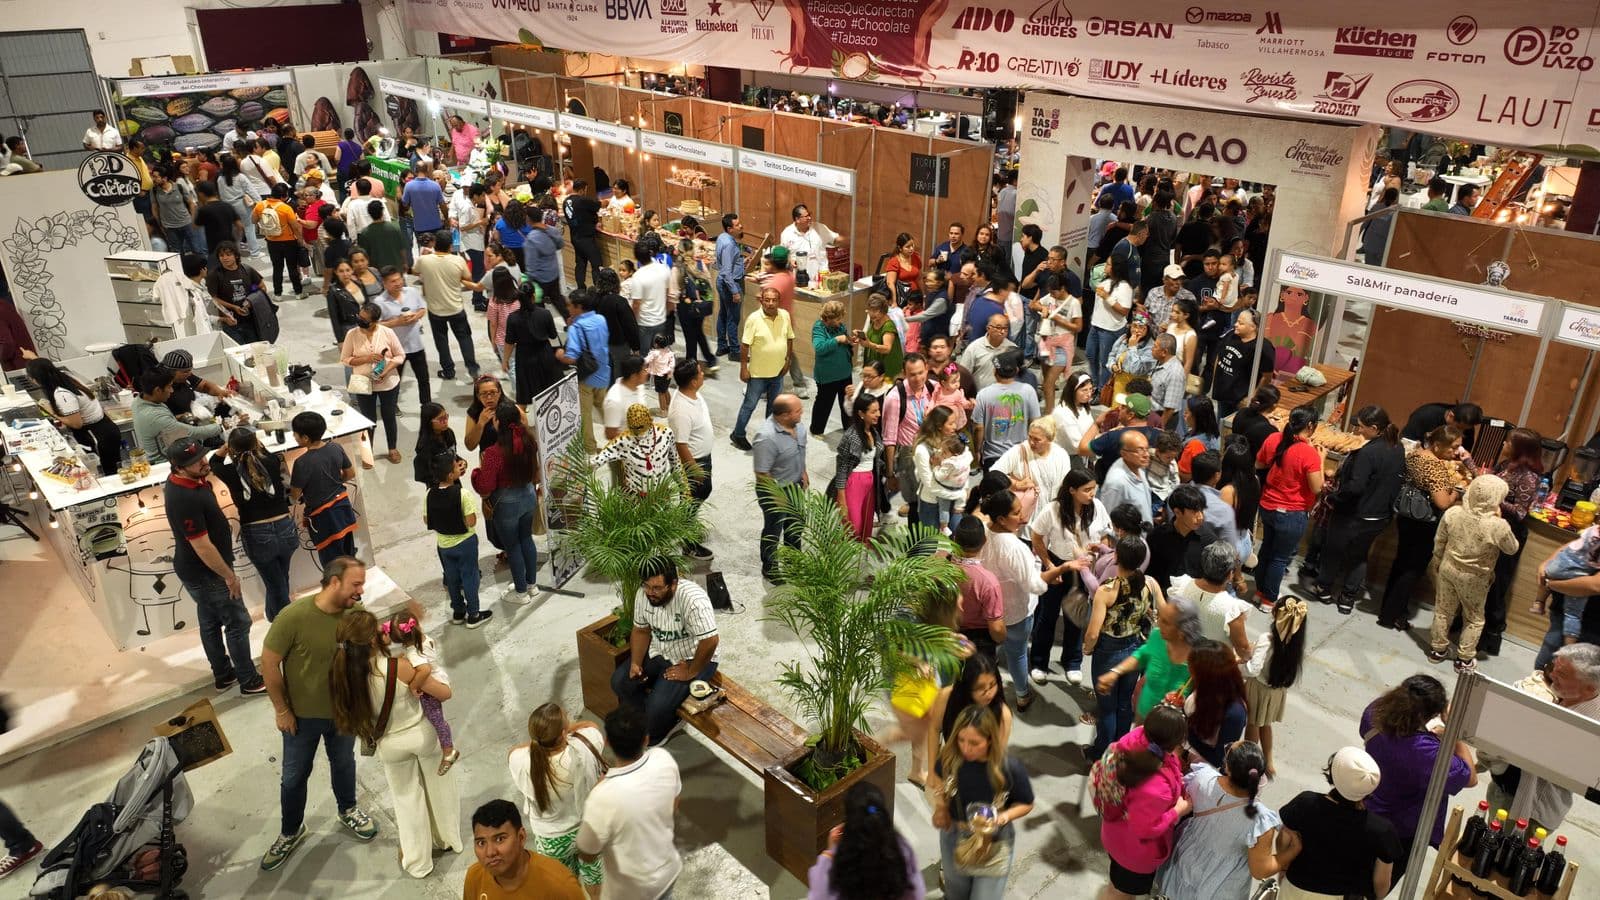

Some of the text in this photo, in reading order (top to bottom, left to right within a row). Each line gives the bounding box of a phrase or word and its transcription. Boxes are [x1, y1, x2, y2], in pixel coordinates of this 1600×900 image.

[606, 0, 652, 20] BBVA
[695, 19, 738, 32] Heineken
[812, 15, 911, 34] #Cacao #Chocolate
[951, 6, 1015, 33] ADO
[1086, 16, 1174, 39] ORSAN
[831, 31, 878, 46] #Tabasco
[1022, 23, 1078, 39] CRUCES
[1335, 26, 1417, 48] Küchen
[1549, 25, 1579, 41] PO
[1197, 38, 1230, 50] Tabasco
[1260, 37, 1305, 46] MARRIOTT
[1546, 42, 1573, 55] ZO
[1258, 47, 1325, 57] VILLAHERMOSA
[1426, 52, 1485, 64] FOTON
[1542, 55, 1594, 72] LAZO
[1150, 68, 1227, 91] +Líderes
[1244, 68, 1297, 86] Revista
[1033, 108, 1044, 117] TA
[1312, 101, 1361, 117] PROMIN
[1032, 118, 1050, 128] BAS
[1031, 128, 1044, 137] CO
[1090, 121, 1248, 165] CAVACAO
[763, 160, 782, 170] Toritos
[782, 163, 795, 173] Don
[795, 166, 817, 178] Enrique
[1346, 275, 1458, 306] Sal&Mir panadería
[1503, 315, 1529, 324] TABASCO
